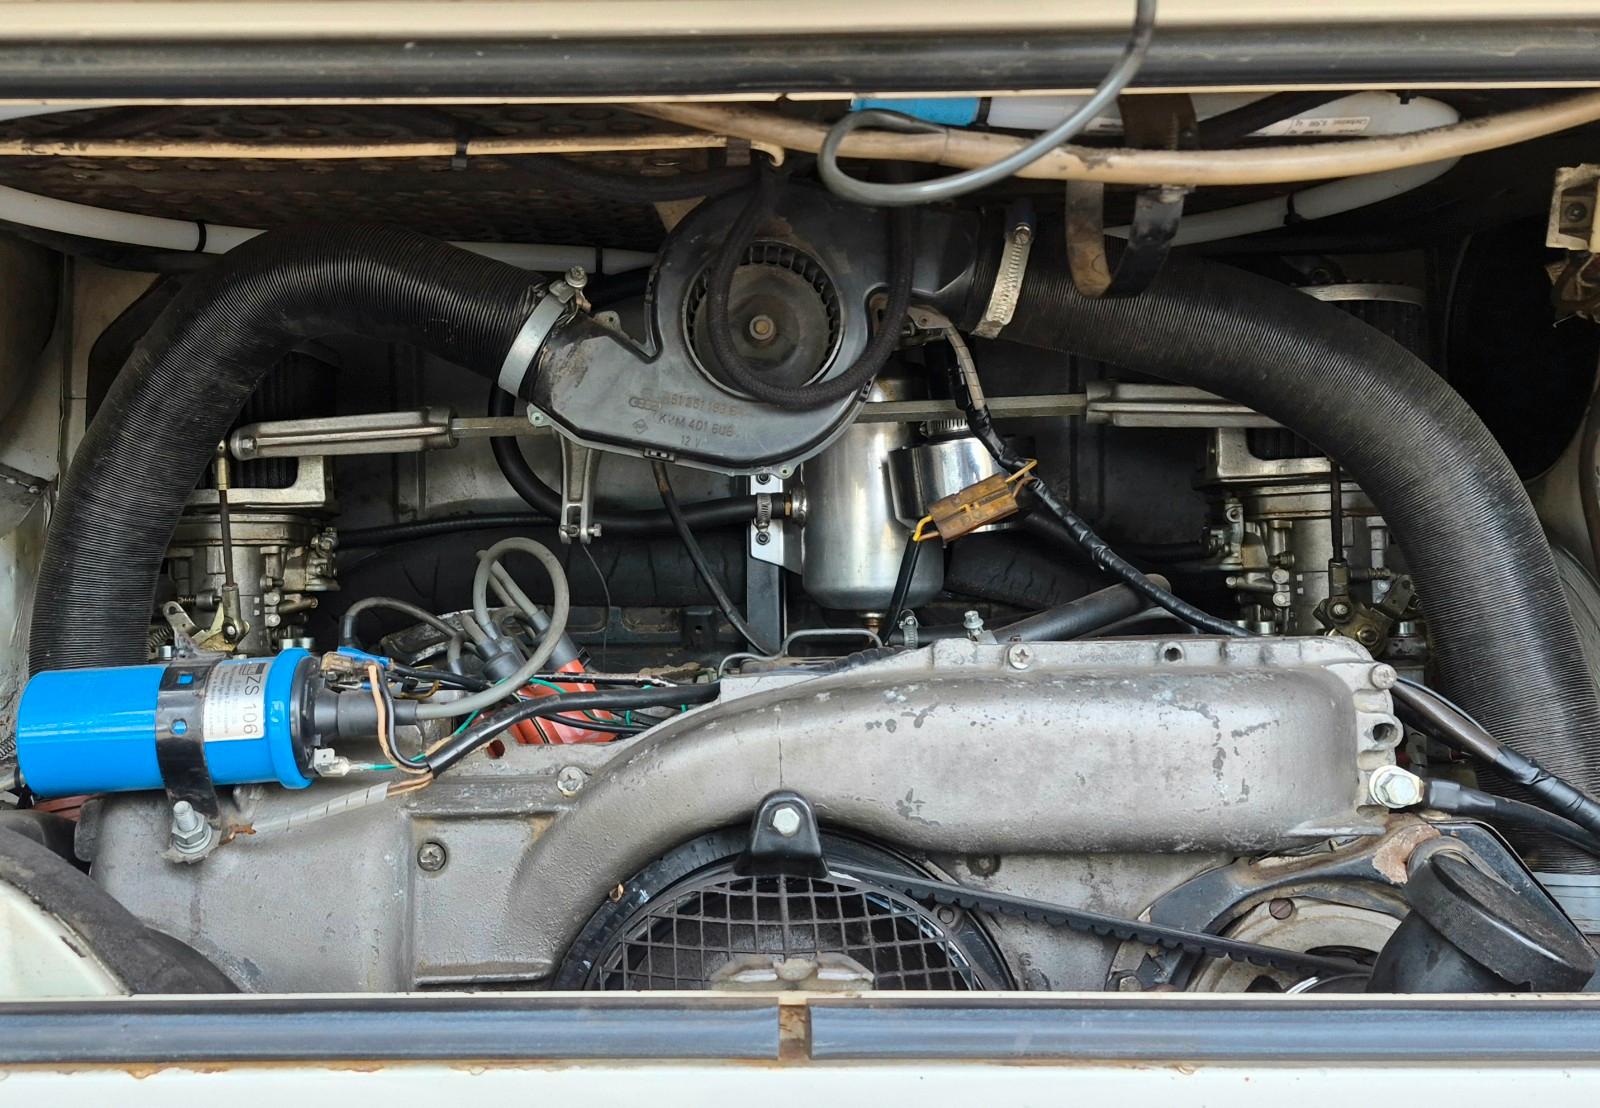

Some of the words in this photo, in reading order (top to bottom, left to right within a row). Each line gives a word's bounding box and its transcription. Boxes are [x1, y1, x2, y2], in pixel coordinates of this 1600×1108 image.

[688, 418, 708, 432] 401
[244, 675, 261, 696] ZS
[242, 703, 258, 734] 106
